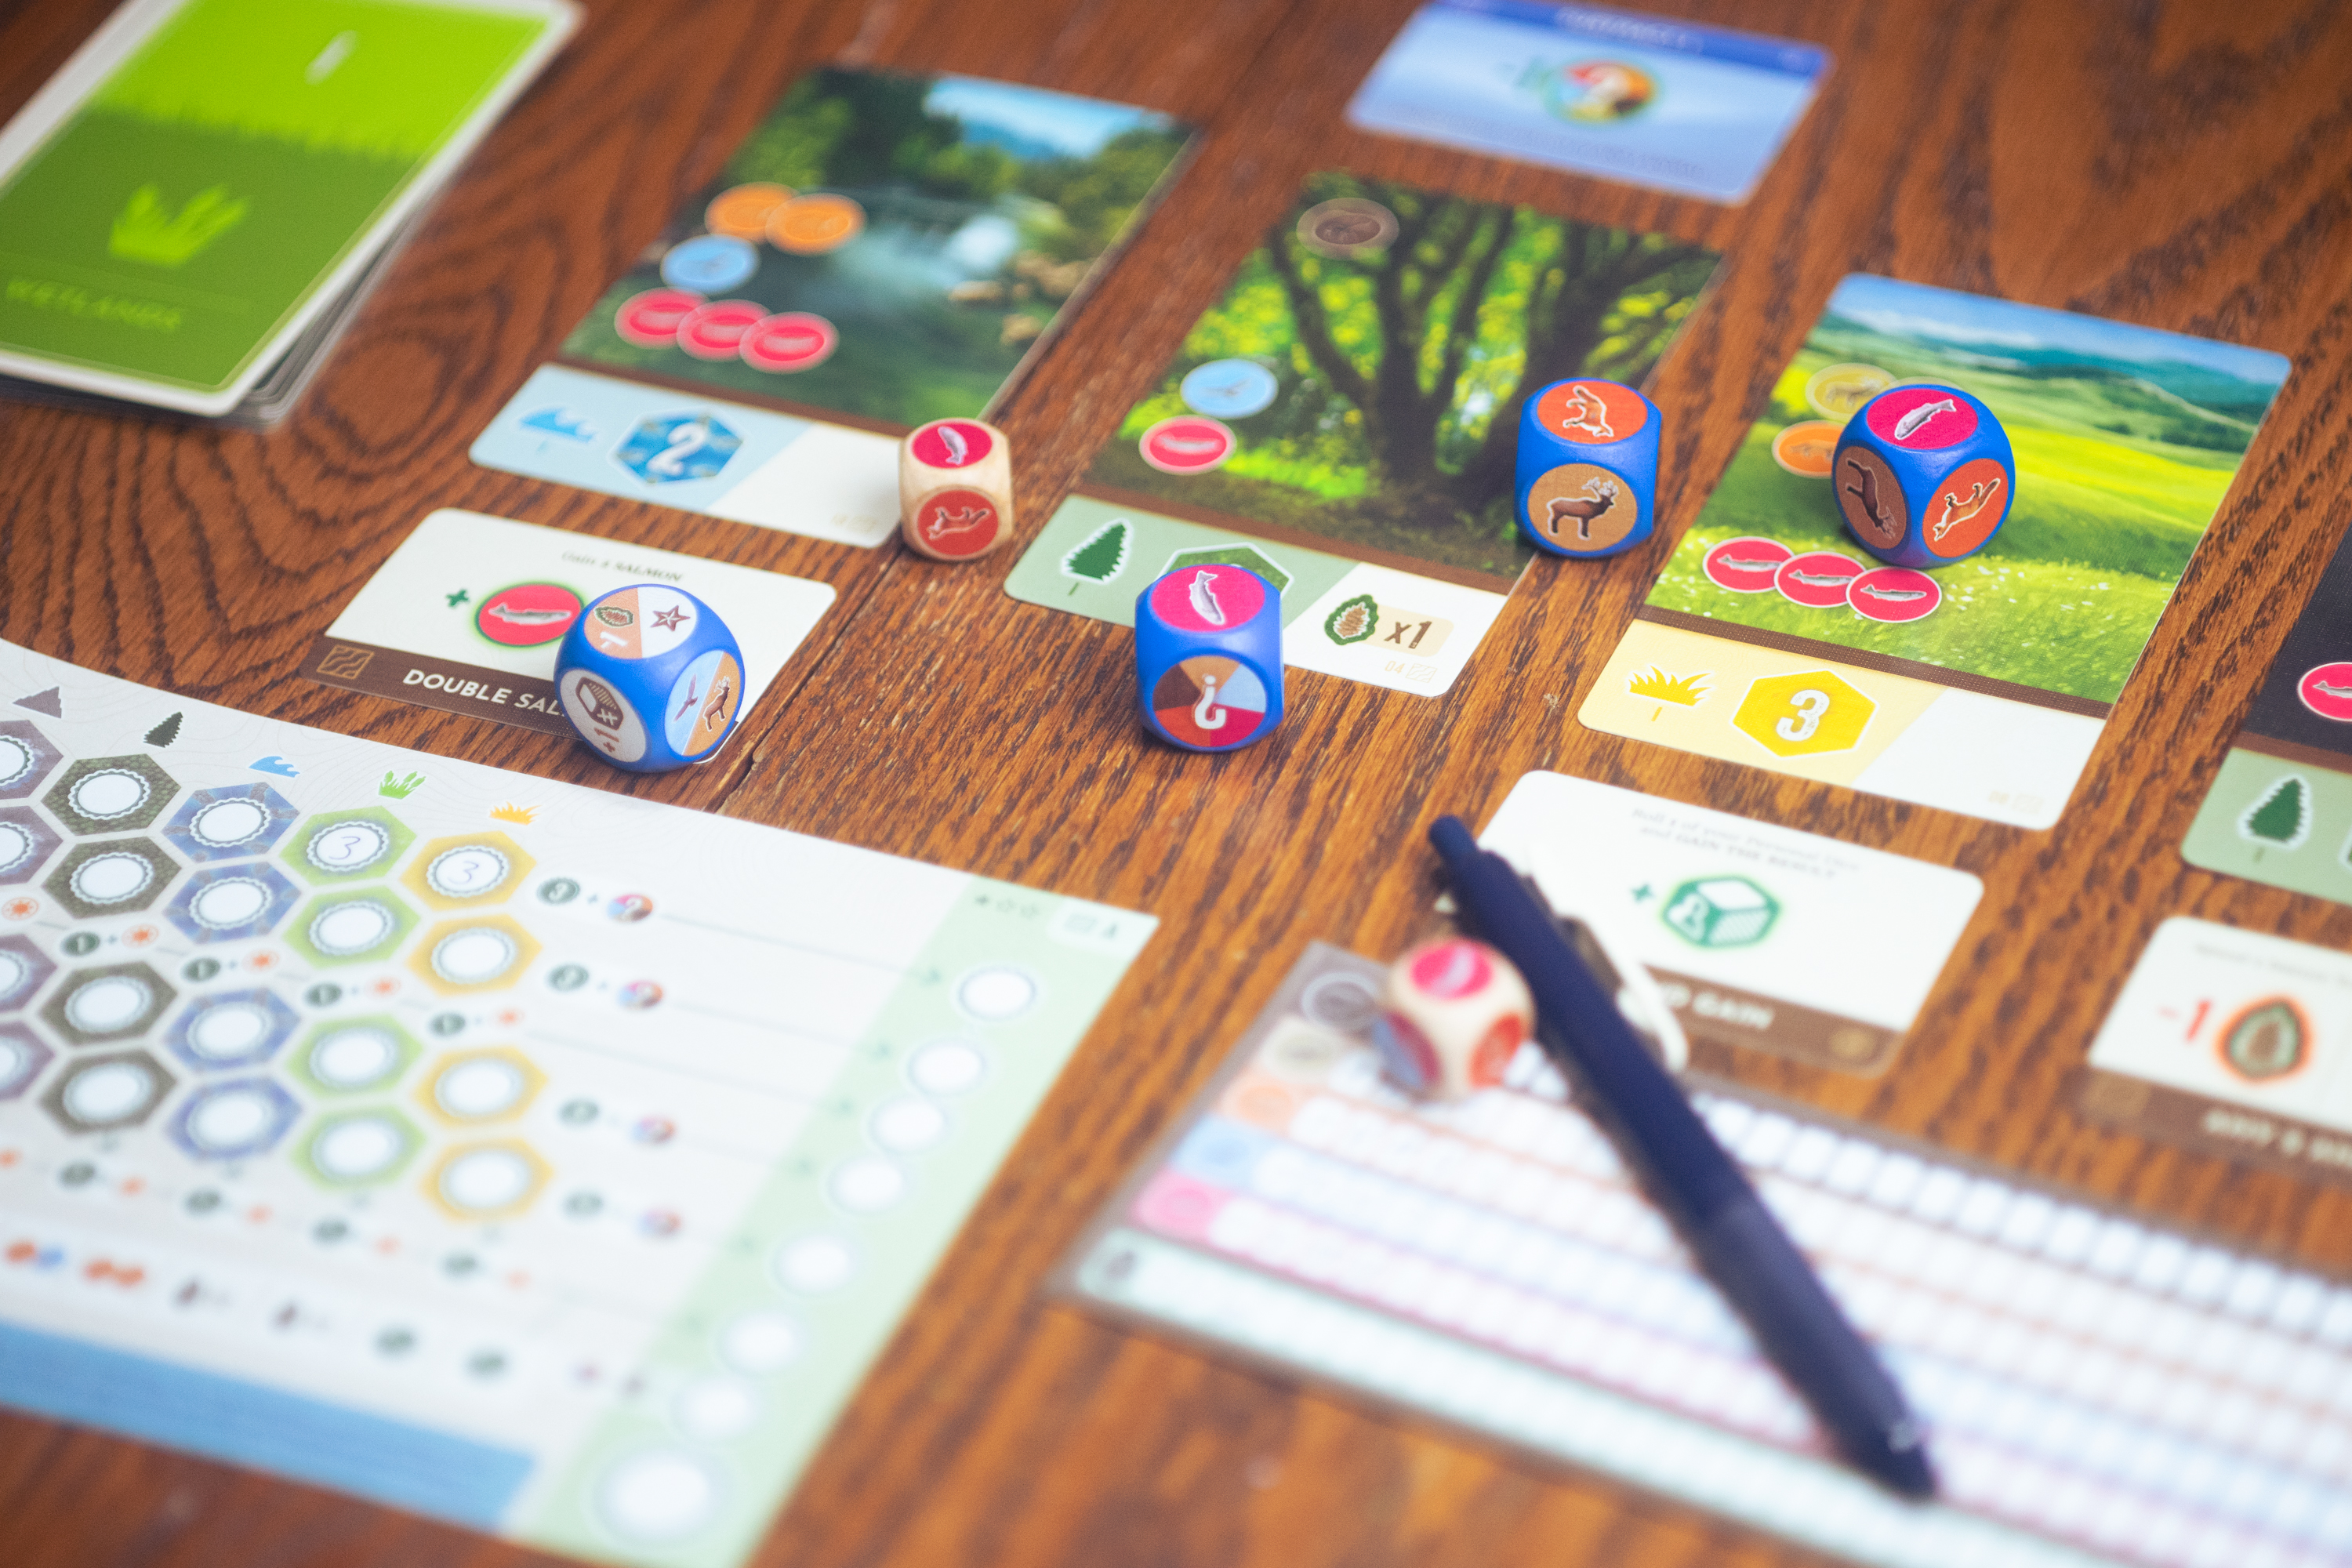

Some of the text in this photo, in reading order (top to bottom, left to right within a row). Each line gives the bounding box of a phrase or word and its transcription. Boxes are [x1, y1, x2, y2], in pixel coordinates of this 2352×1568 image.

[647, 423, 706, 476] 2
[614, 561, 683, 582] SALMON
[1384, 621, 1432, 649] x1
[1385, 660, 1406, 673] 04
[402, 669, 565, 717] DOUBLE SAL
[1776, 689, 1830, 742] 3
[329, 836, 361, 860] 3
[447, 861, 479, 884] 3
